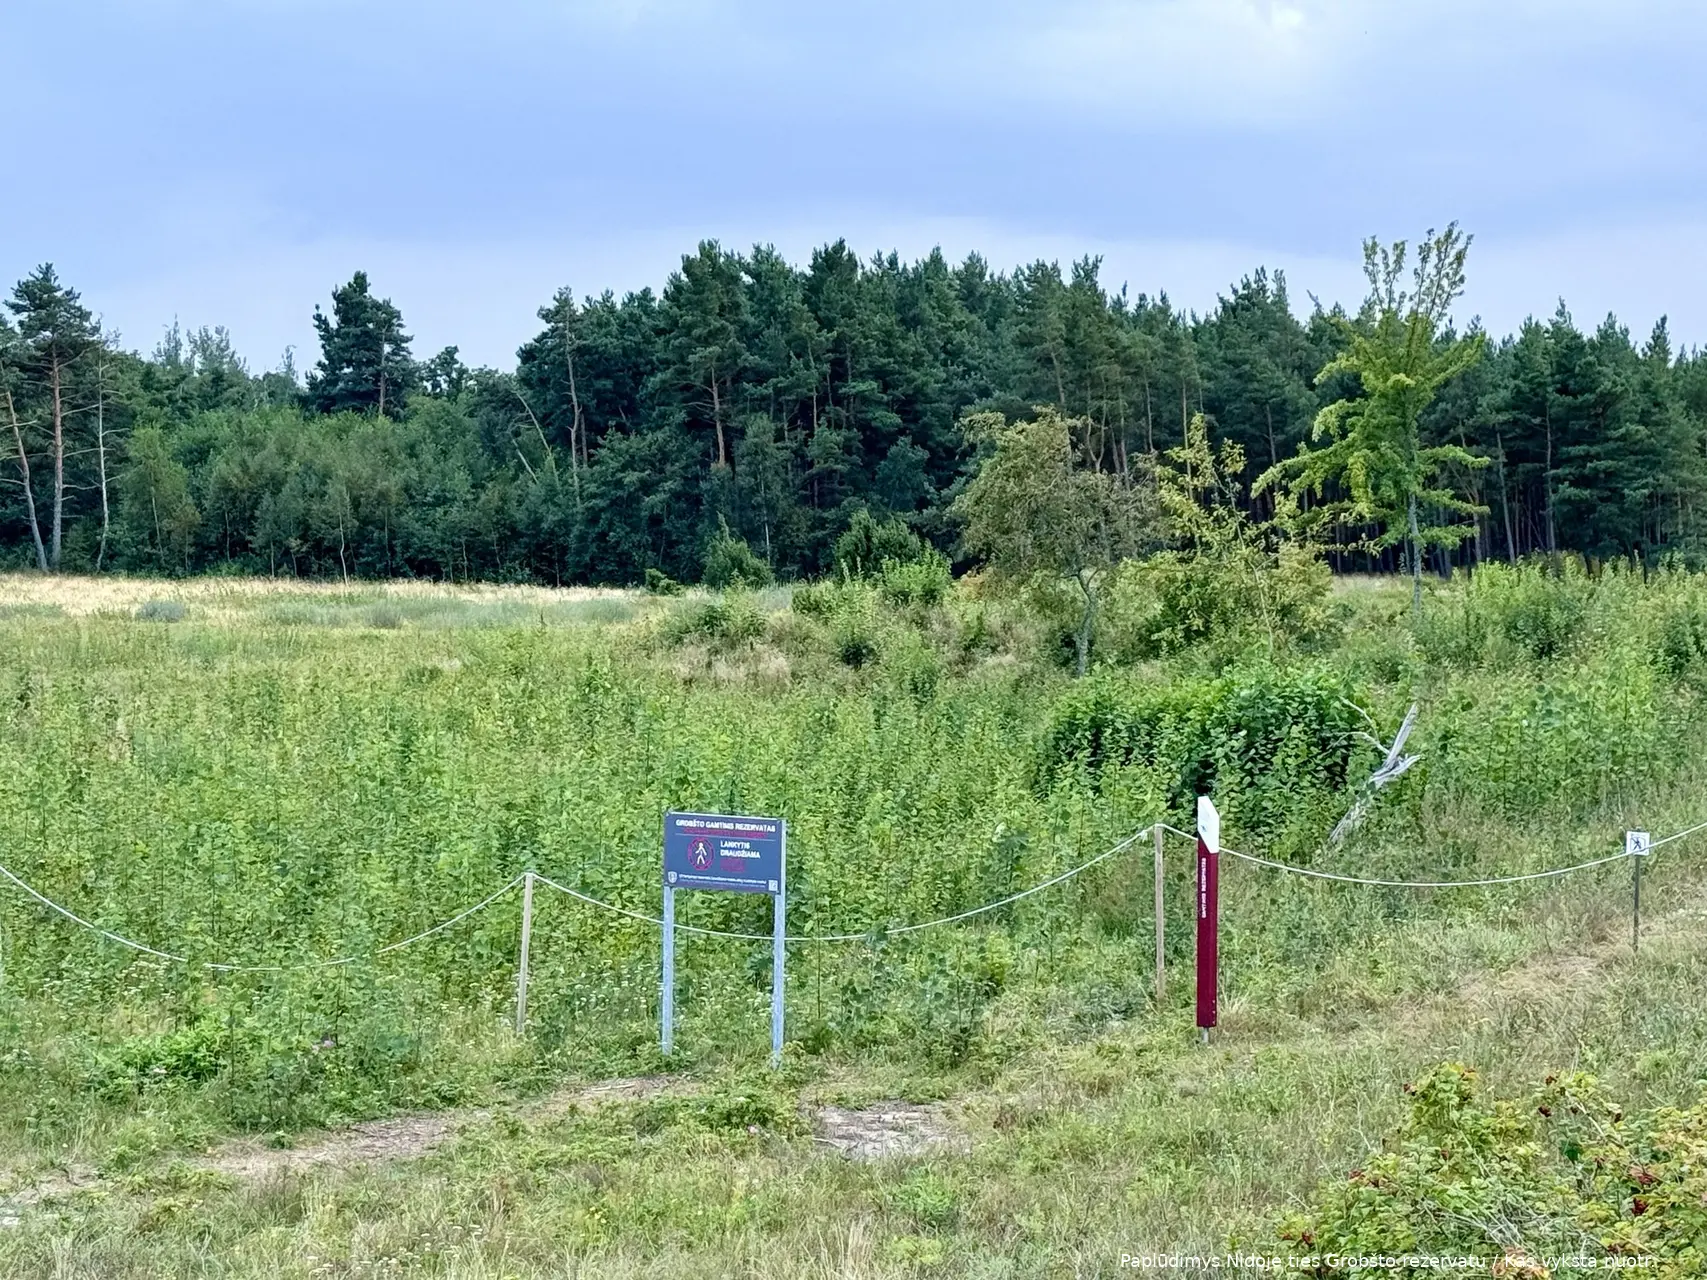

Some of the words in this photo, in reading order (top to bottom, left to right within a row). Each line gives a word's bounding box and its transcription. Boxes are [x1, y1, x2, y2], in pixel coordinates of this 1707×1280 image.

[676, 819, 705, 828] GROBŠTO
[706, 821, 734, 830] GAMTINIS
[735, 823, 776, 833] REZERVATAS
[720, 840, 751, 849] LANKYTIS
[720, 849, 761, 859] DRAUDŽIAMA
